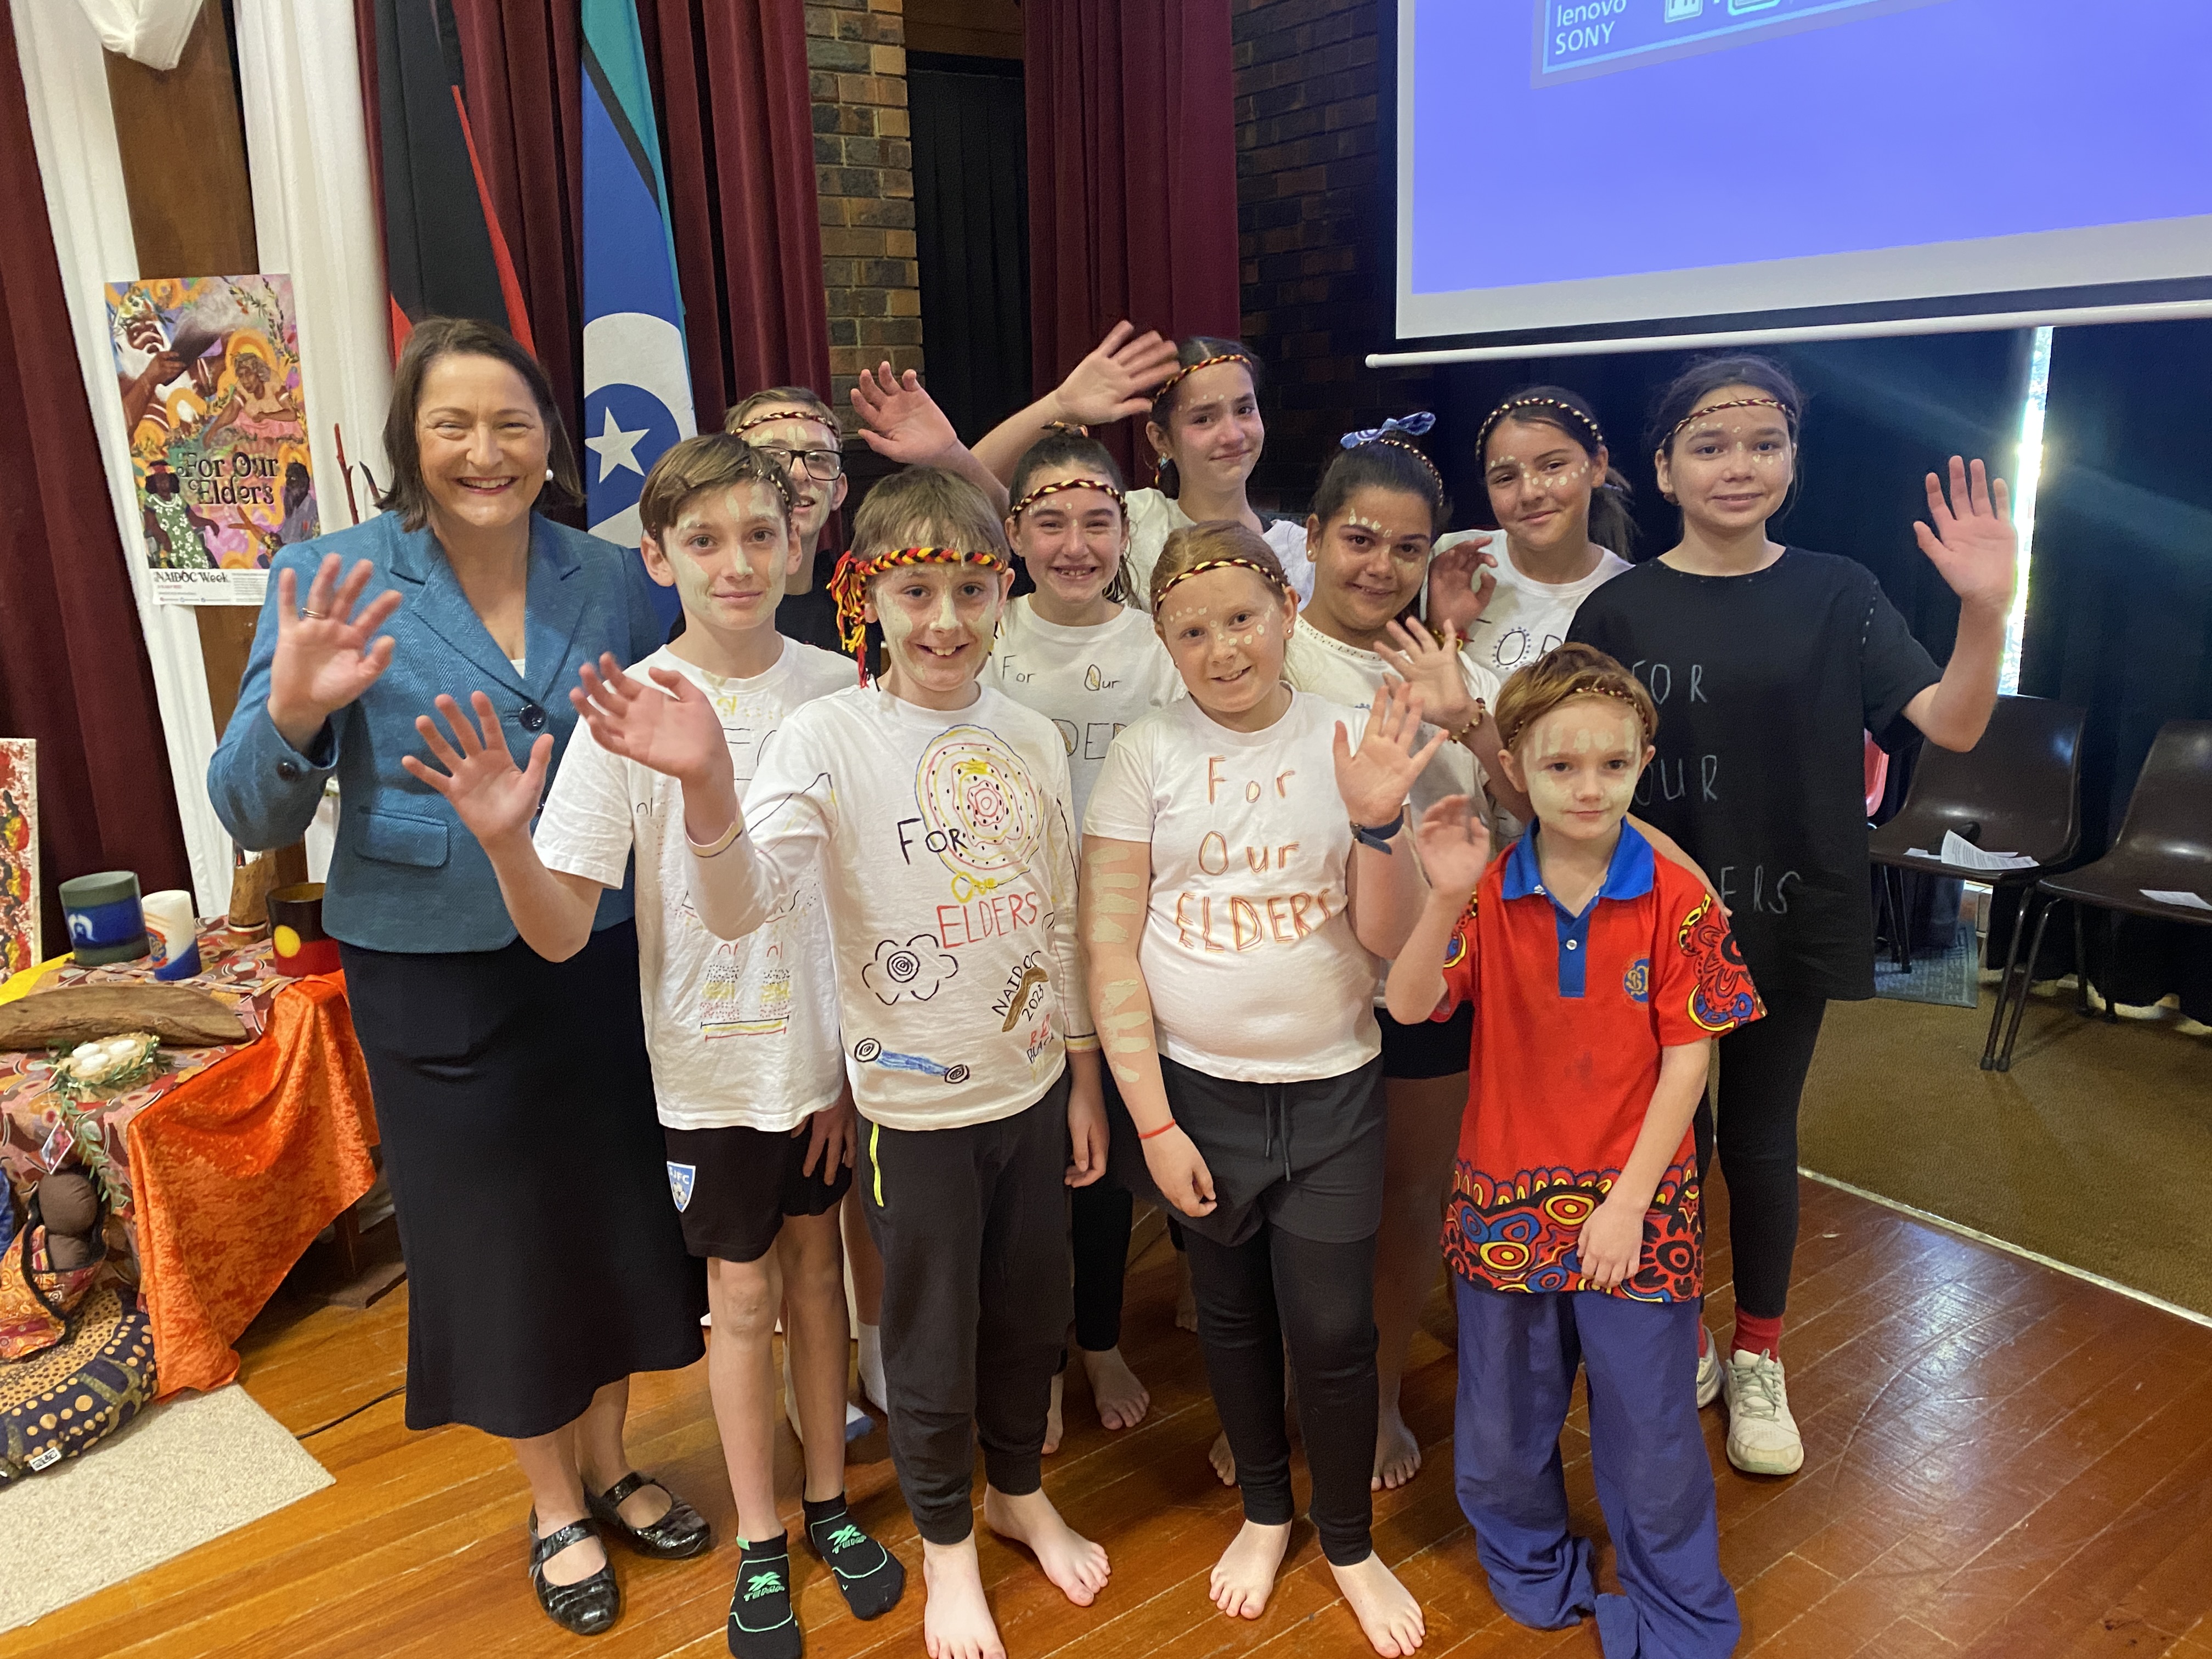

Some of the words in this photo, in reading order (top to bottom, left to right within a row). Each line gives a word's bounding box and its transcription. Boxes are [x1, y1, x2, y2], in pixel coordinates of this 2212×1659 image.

[1555, 21, 1616, 55] SONY
[176, 452, 225, 478] For
[232, 452, 279, 478] Our
[188, 475, 275, 505] Elders
[154, 571, 198, 583] NAIDOC
[198, 572, 231, 583] Week
[1002, 654, 1035, 683] For
[1084, 664, 1121, 691] Our
[1208, 755, 1296, 804] For
[897, 817, 968, 865] FOR
[1198, 831, 1300, 876] Our
[936, 891, 1037, 949] ELDERS
[1176, 888, 1330, 953] ELDERS
[991, 950, 1041, 1017] NAIDOC
[1022, 984, 1044, 1022] 2023
